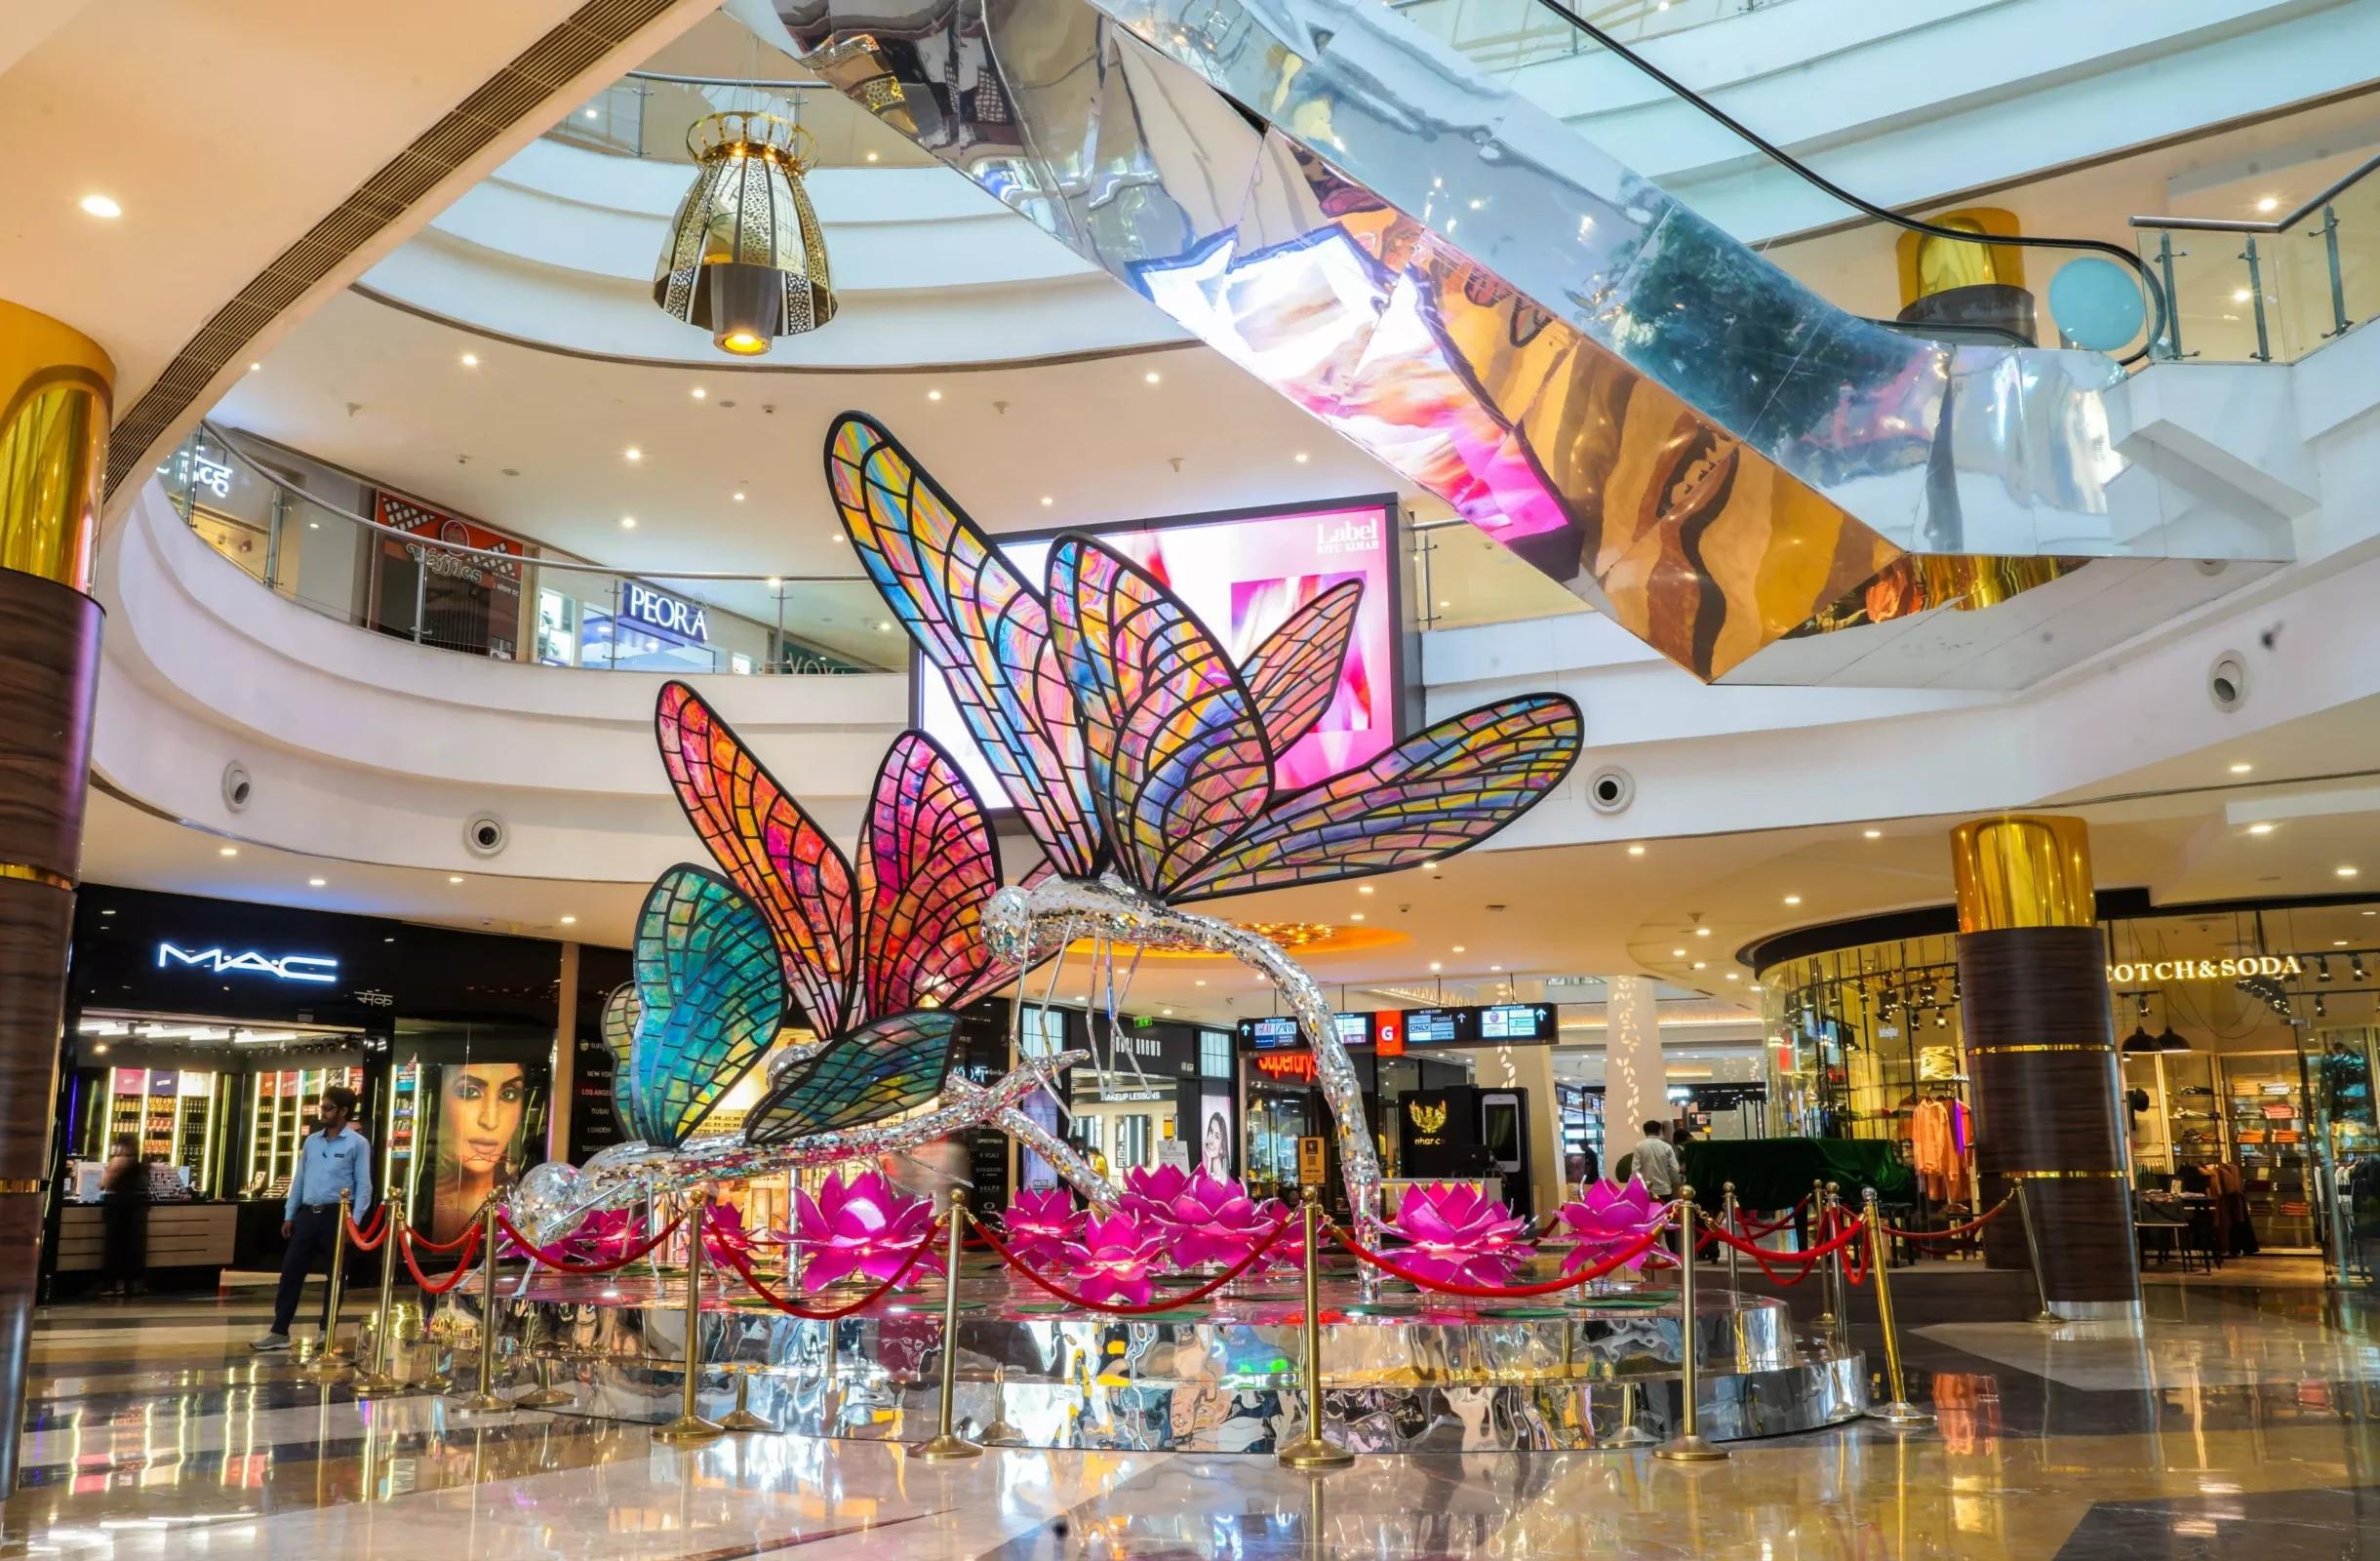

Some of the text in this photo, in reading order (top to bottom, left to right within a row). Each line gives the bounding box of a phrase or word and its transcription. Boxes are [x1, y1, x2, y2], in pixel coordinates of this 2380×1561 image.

[1317, 518, 1378, 544] Label
[630, 584, 708, 641] PEORA
[2106, 955, 2302, 982] OTCH&SODA
[1381, 1026, 1394, 1041] G
